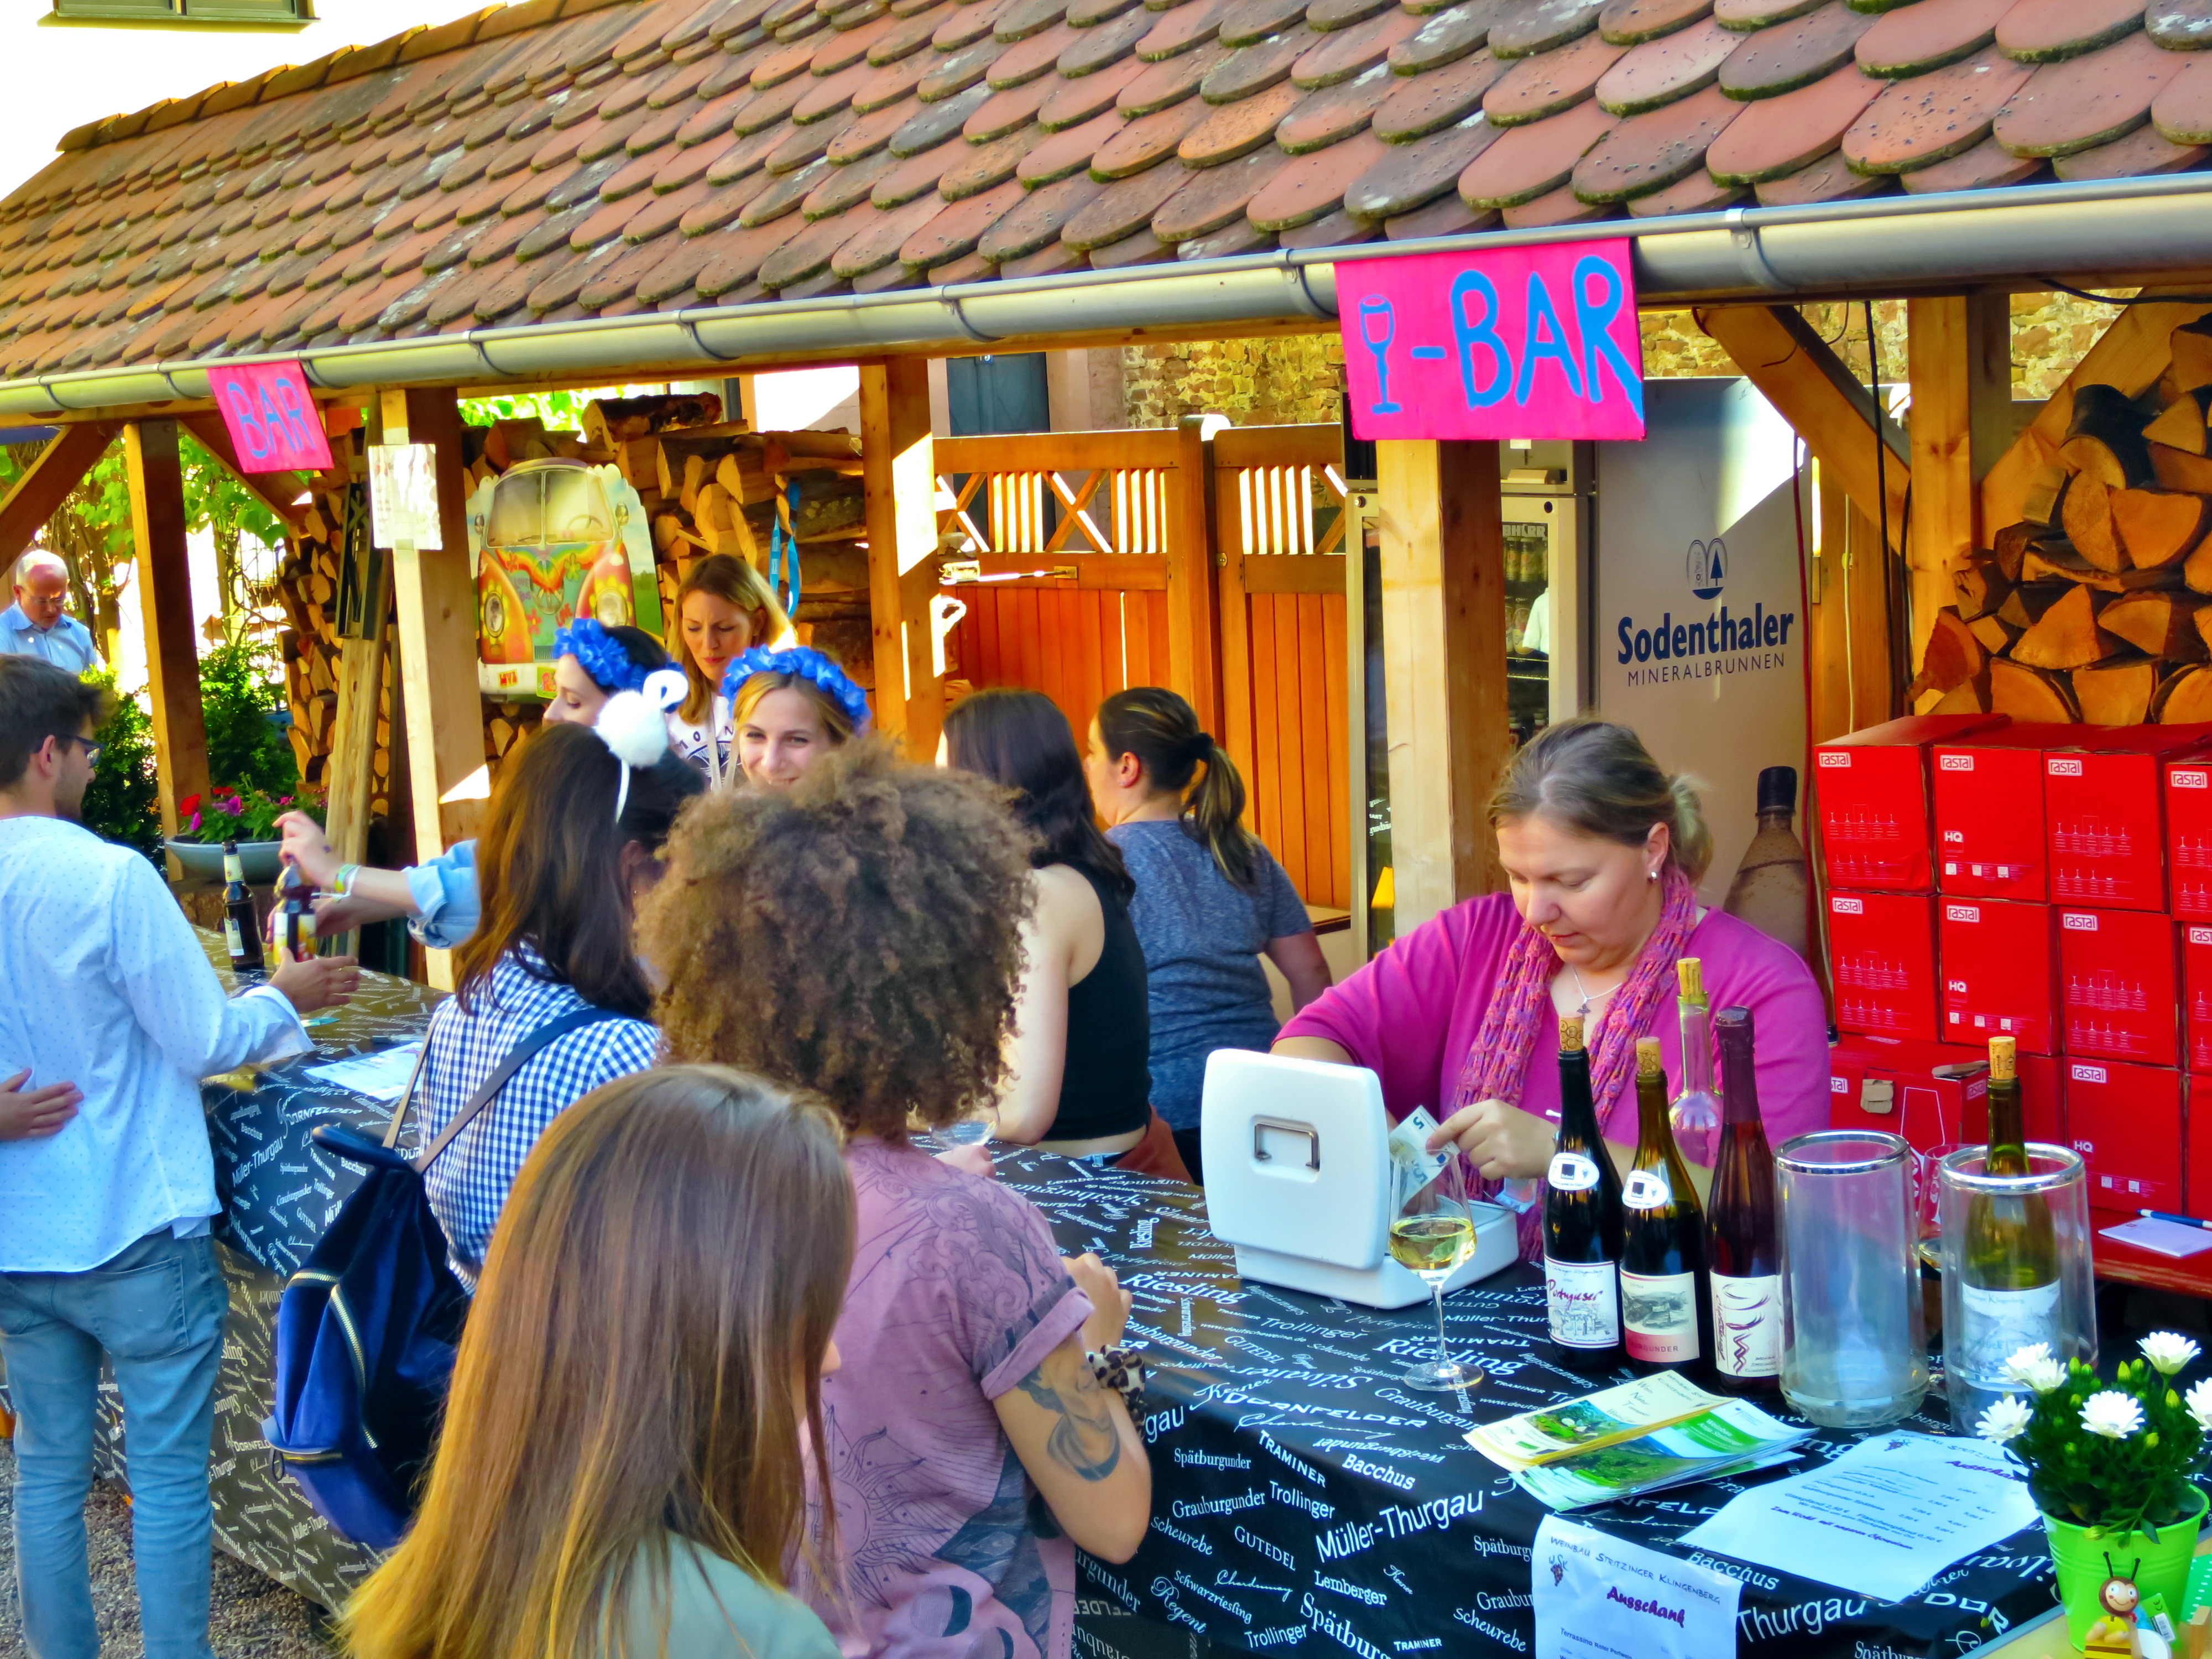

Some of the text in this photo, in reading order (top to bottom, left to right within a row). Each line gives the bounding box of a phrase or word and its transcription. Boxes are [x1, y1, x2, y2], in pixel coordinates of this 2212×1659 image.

[227, 378, 316, 458] BAR
[1618, 603, 1794, 665] Sodenthaler
[1628, 653, 1785, 687] MINERALBRUNNEN
[1820, 754, 1849, 765] rastal
[1942, 757, 1971, 769] rastal
[2050, 761, 2080, 774] rastal
[2173, 773, 2205, 786] rastal
[1945, 831, 1963, 843] HQ
[1834, 899, 1861, 912] rastal
[1949, 907, 1978, 920] rastal
[2065, 916, 2096, 928] rastal
[1949, 981, 1966, 993] HQ
[2074, 1067, 2104, 1081] rastal
[285, 1106, 363, 1126] DORNFELDER
[1412, 1115, 1425, 1130] 5
[2074, 1140, 2093, 1153] HQ
[231, 1136, 284, 1188] Müller-Thurgau
[310, 1146, 337, 1181] TRAMINER
[340, 1156, 367, 1177] Bacchus
[296, 1207, 317, 1234] GUTEDEL
[1129, 1217, 1160, 1250] Riesling
[1118, 1272, 1252, 1305] Riesling
[1217, 1307, 1261, 1321] TRAMINER
[1260, 1317, 1368, 1340] Trollinger
[1223, 1335, 1285, 1364] GUTEDEL
[1371, 1338, 1532, 1376] Riesling
[1229, 1364, 1374, 1390] Silvaner
[1494, 1379, 1546, 1395] TRAMINER
[1222, 1392, 1429, 1428] DORNFELDER
[1174, 1448, 1251, 1472] Spätburgunder
[1258, 1429, 1326, 1488] TRAMINER
[1312, 1437, 1447, 1465] Weißburgunder
[1341, 1453, 1416, 1491] Bacchus
[1172, 1486, 1266, 1519] Grauburgunder
[1269, 1479, 1336, 1520] Trollinger
[1785, 1492, 1825, 1507] Glaspfand
[1856, 1513, 1917, 1535] Flaschenpfand
[1315, 1489, 1484, 1563] Müller-Thurgau
[1234, 1525, 1296, 1572] GUTEDEL
[1551, 1536, 1721, 1605] WEINBAU STRITZINGER KLINGENBERG
[1687, 1550, 1780, 1591] Bacchus
[1174, 1569, 1253, 1625] Schwarzriesling
[1214, 1568, 1293, 1603] Chardonnay
[1313, 1569, 1388, 1606] Lemberger
[1150, 1575, 1207, 1635] Regent
[1606, 1585, 1685, 1629] Ausschank
[1244, 1621, 1308, 1649] Trollinger
[1394, 1637, 1443, 1652] TRAMINER
